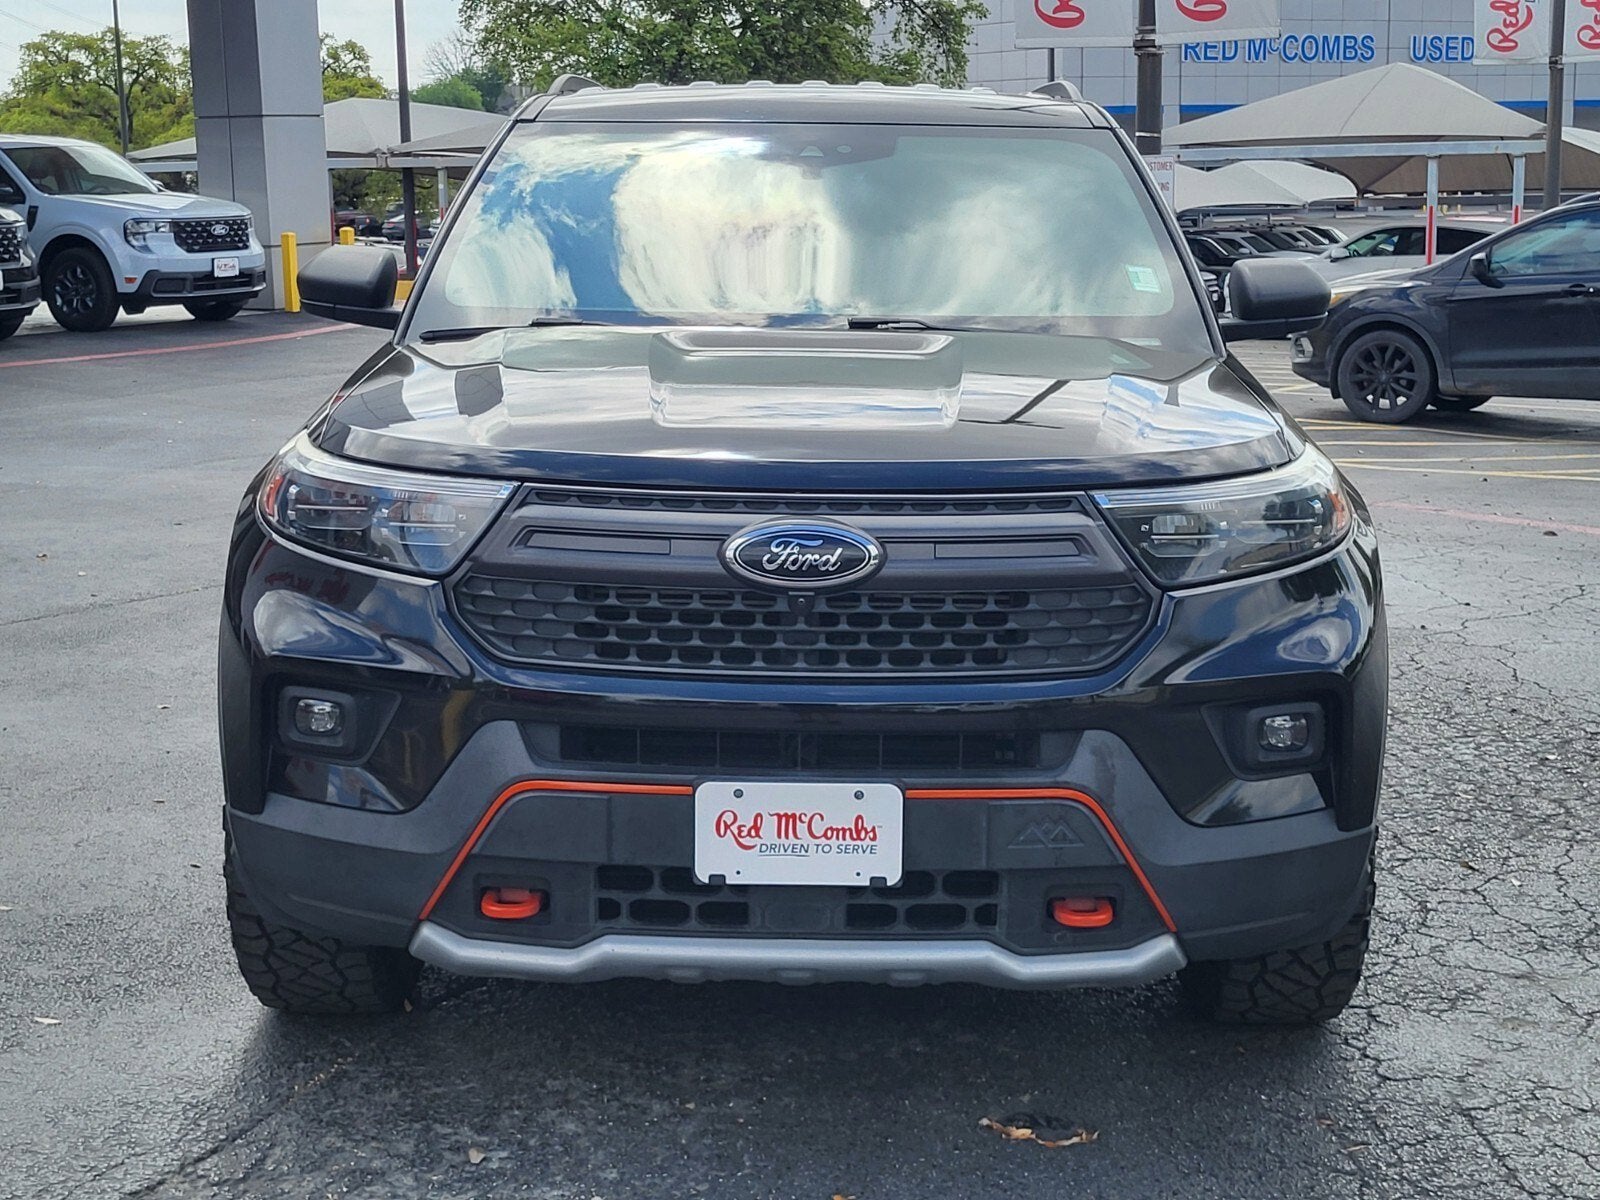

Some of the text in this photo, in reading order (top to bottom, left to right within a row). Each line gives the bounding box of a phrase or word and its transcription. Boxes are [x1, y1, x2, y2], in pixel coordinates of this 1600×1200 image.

[1486, 0, 1533, 52] Red
[1183, 42, 1238, 61] RED
[1411, 35, 1474, 62] USED
[1148, 161, 1173, 171] STOMER
[762, 538, 844, 571] Ford
[715, 809, 878, 851] Red McCombs
[759, 843, 878, 855] DRIVEN TO SERVE
